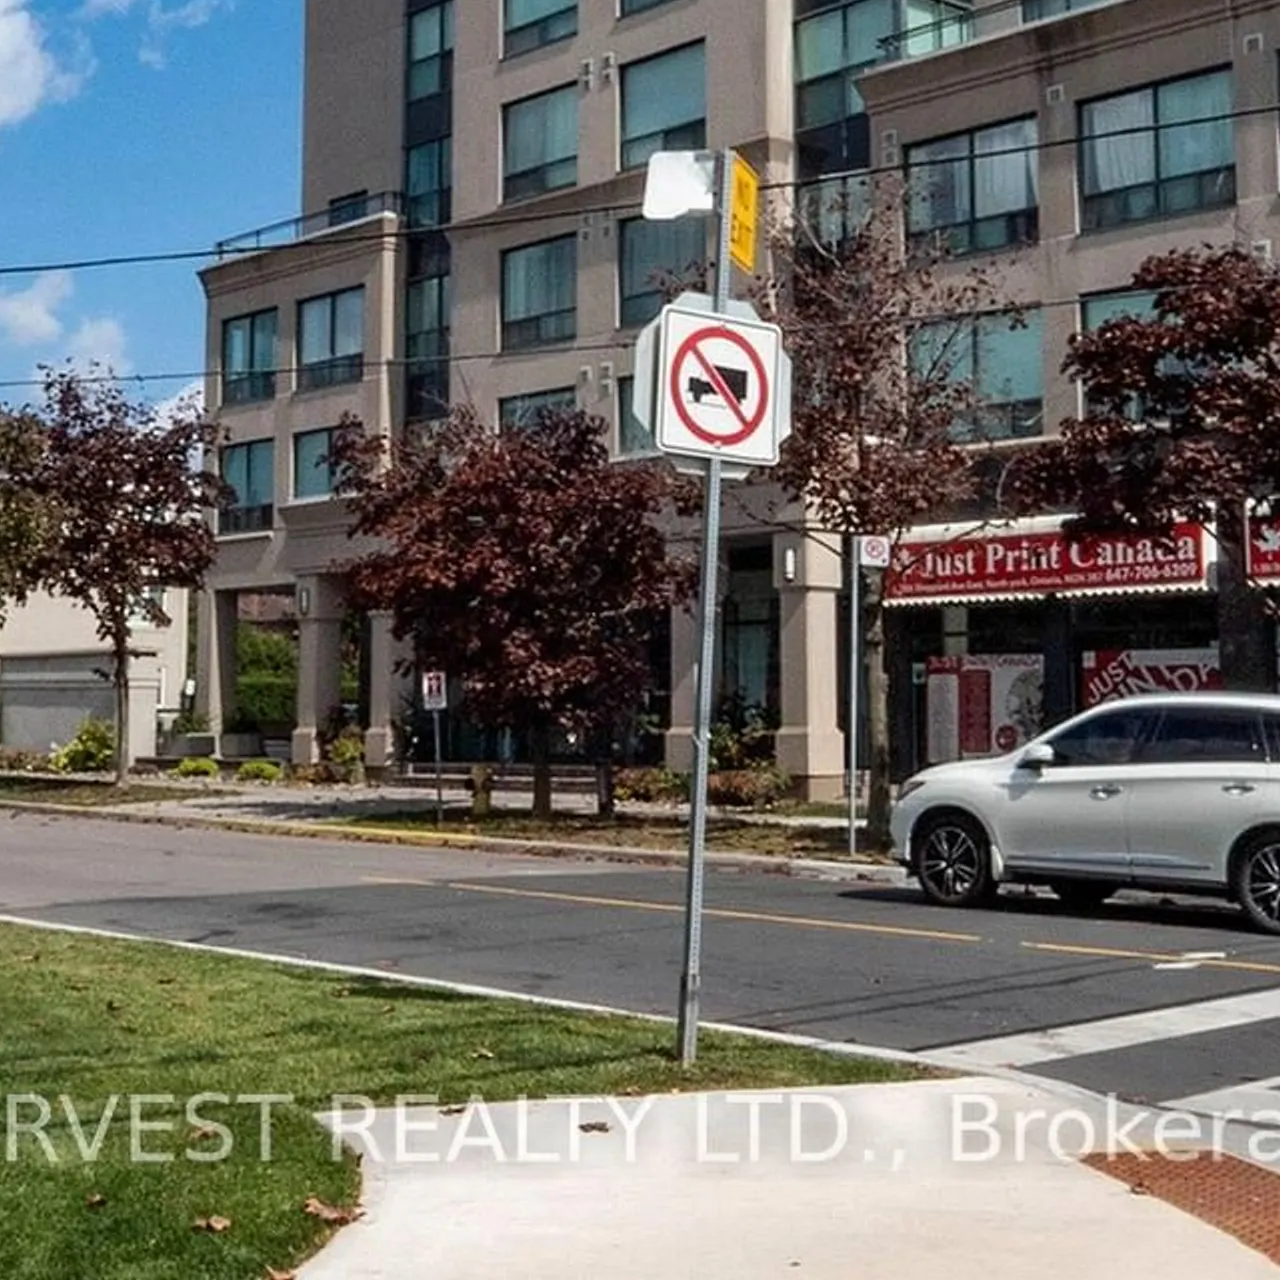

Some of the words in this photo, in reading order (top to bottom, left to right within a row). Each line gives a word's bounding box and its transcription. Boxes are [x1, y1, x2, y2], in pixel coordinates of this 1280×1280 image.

[921, 548, 976, 578] Just
[986, 539, 1061, 574] Print
[1087, 649, 1136, 704] JUST
